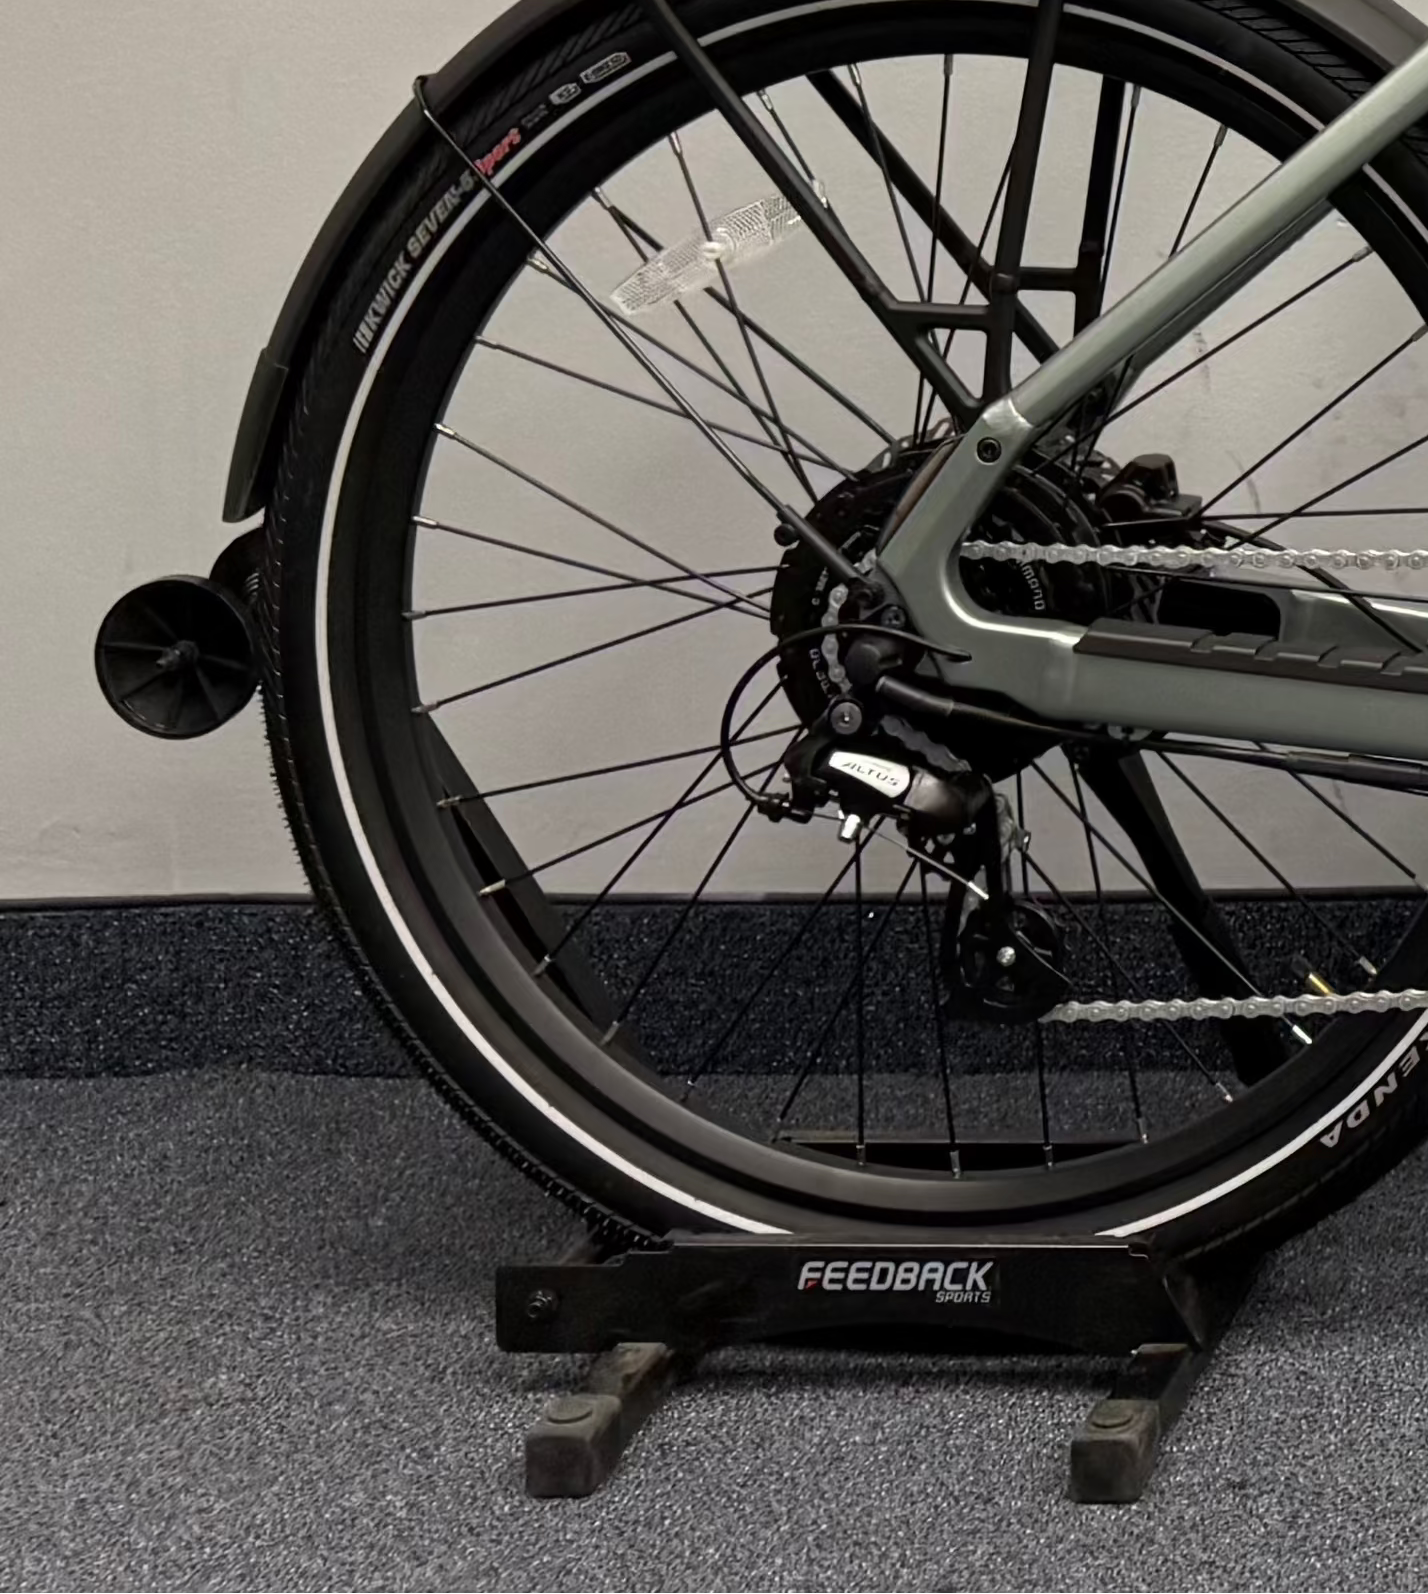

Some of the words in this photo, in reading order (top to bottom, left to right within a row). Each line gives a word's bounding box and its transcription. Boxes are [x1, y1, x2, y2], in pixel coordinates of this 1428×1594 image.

[362, 250, 412, 331] KWICK
[841, 761, 899, 787] ALTUS
[797, 1260, 994, 1291] FEEDBACK
[935, 1290, 992, 1304] SPORTS
